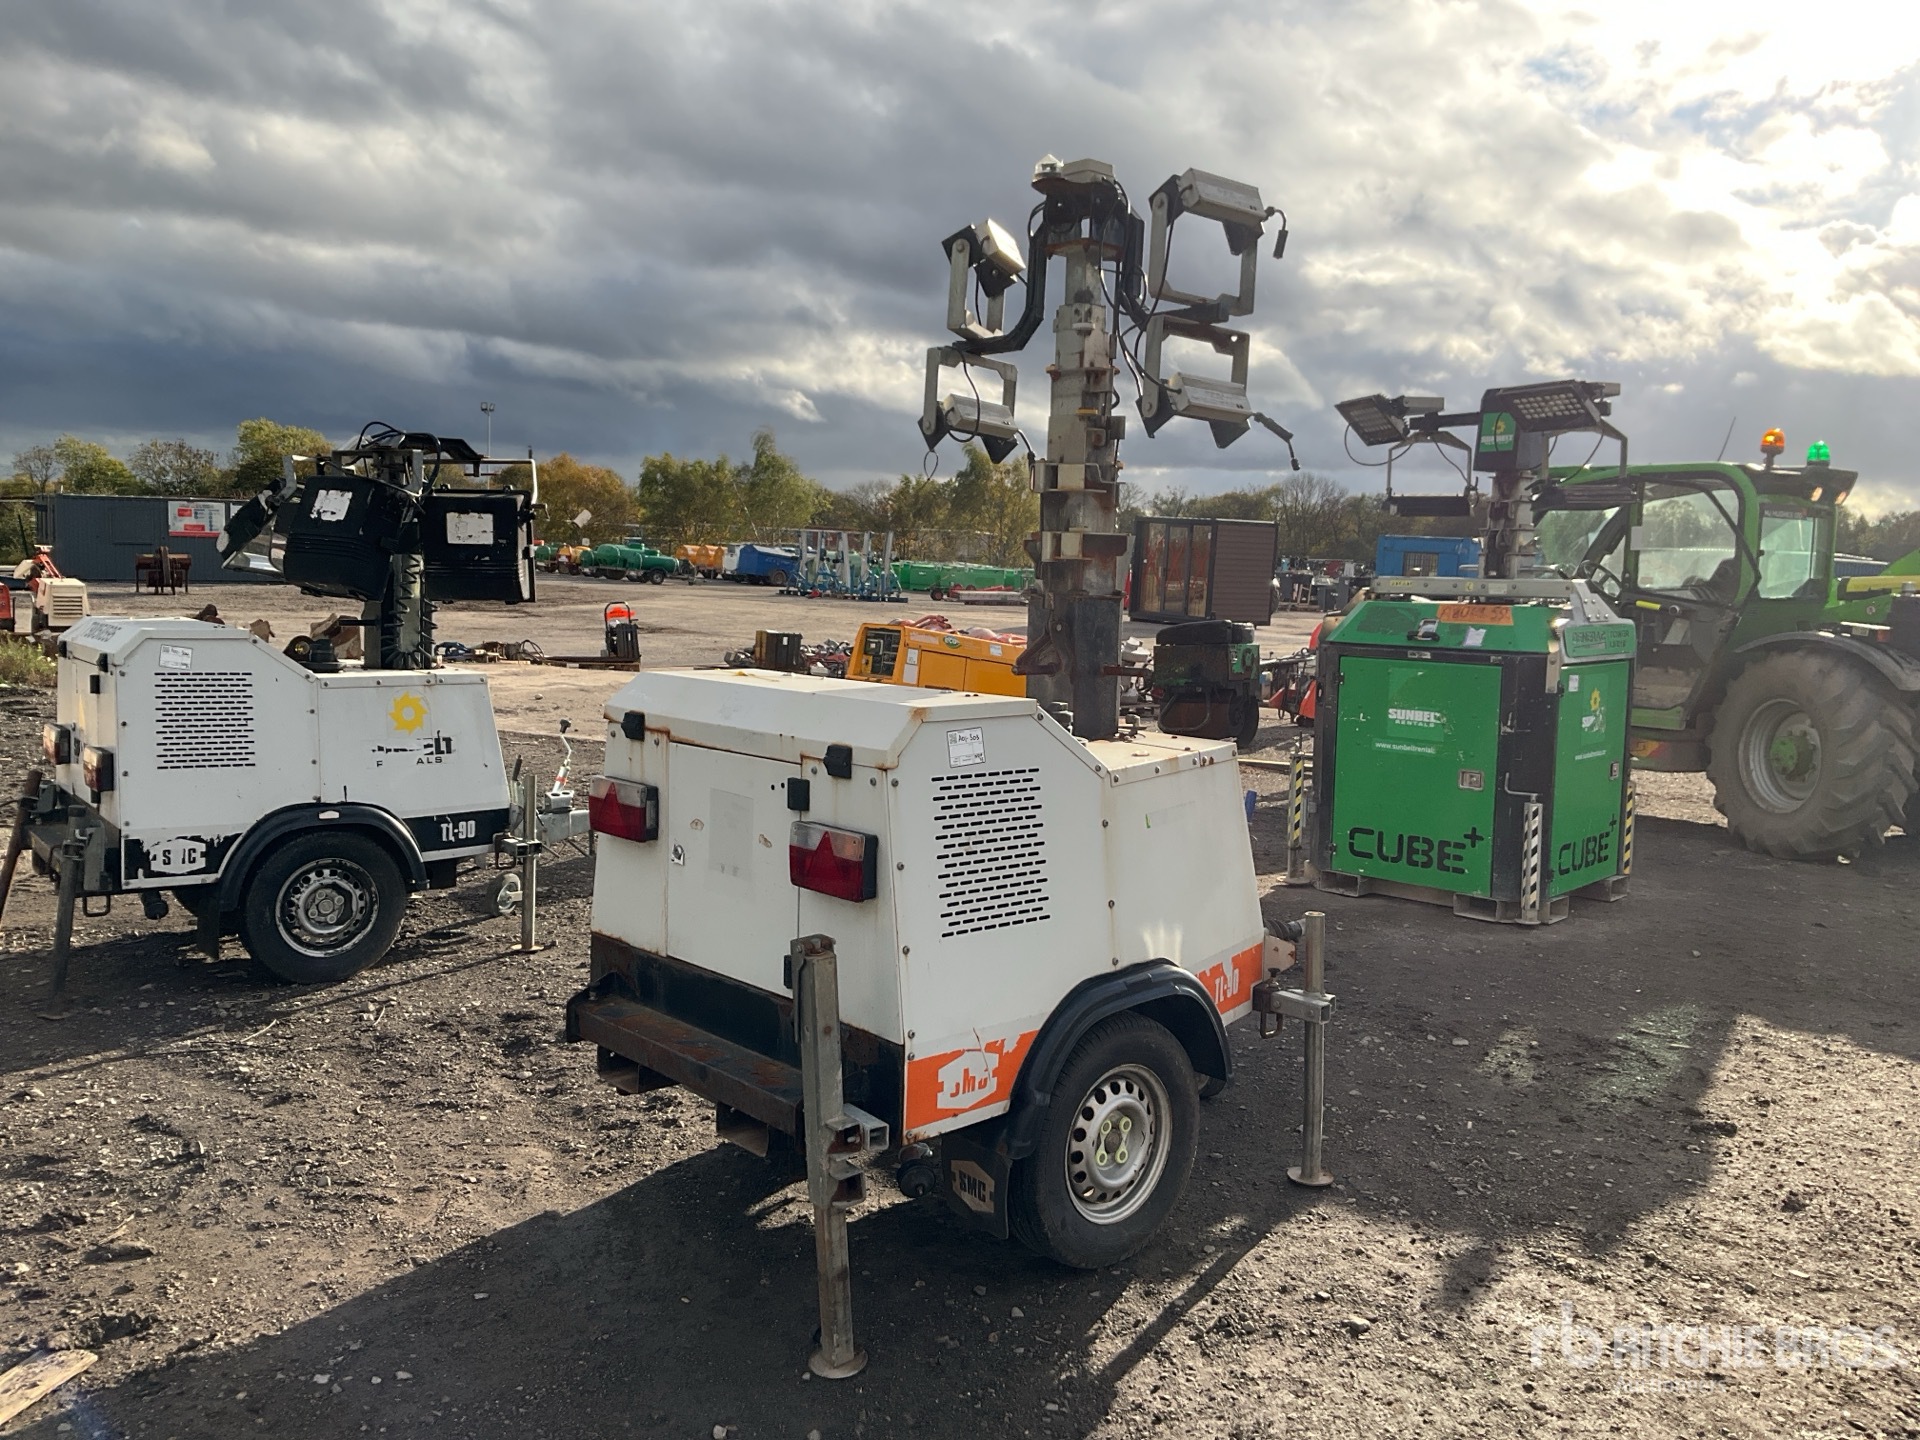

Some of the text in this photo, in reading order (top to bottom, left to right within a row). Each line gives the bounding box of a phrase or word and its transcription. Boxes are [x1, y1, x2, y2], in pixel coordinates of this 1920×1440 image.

[1395, 719, 1435, 728] RENTALS
[440, 820, 476, 843] TL-90
[958, 1169, 987, 1203] SMC
